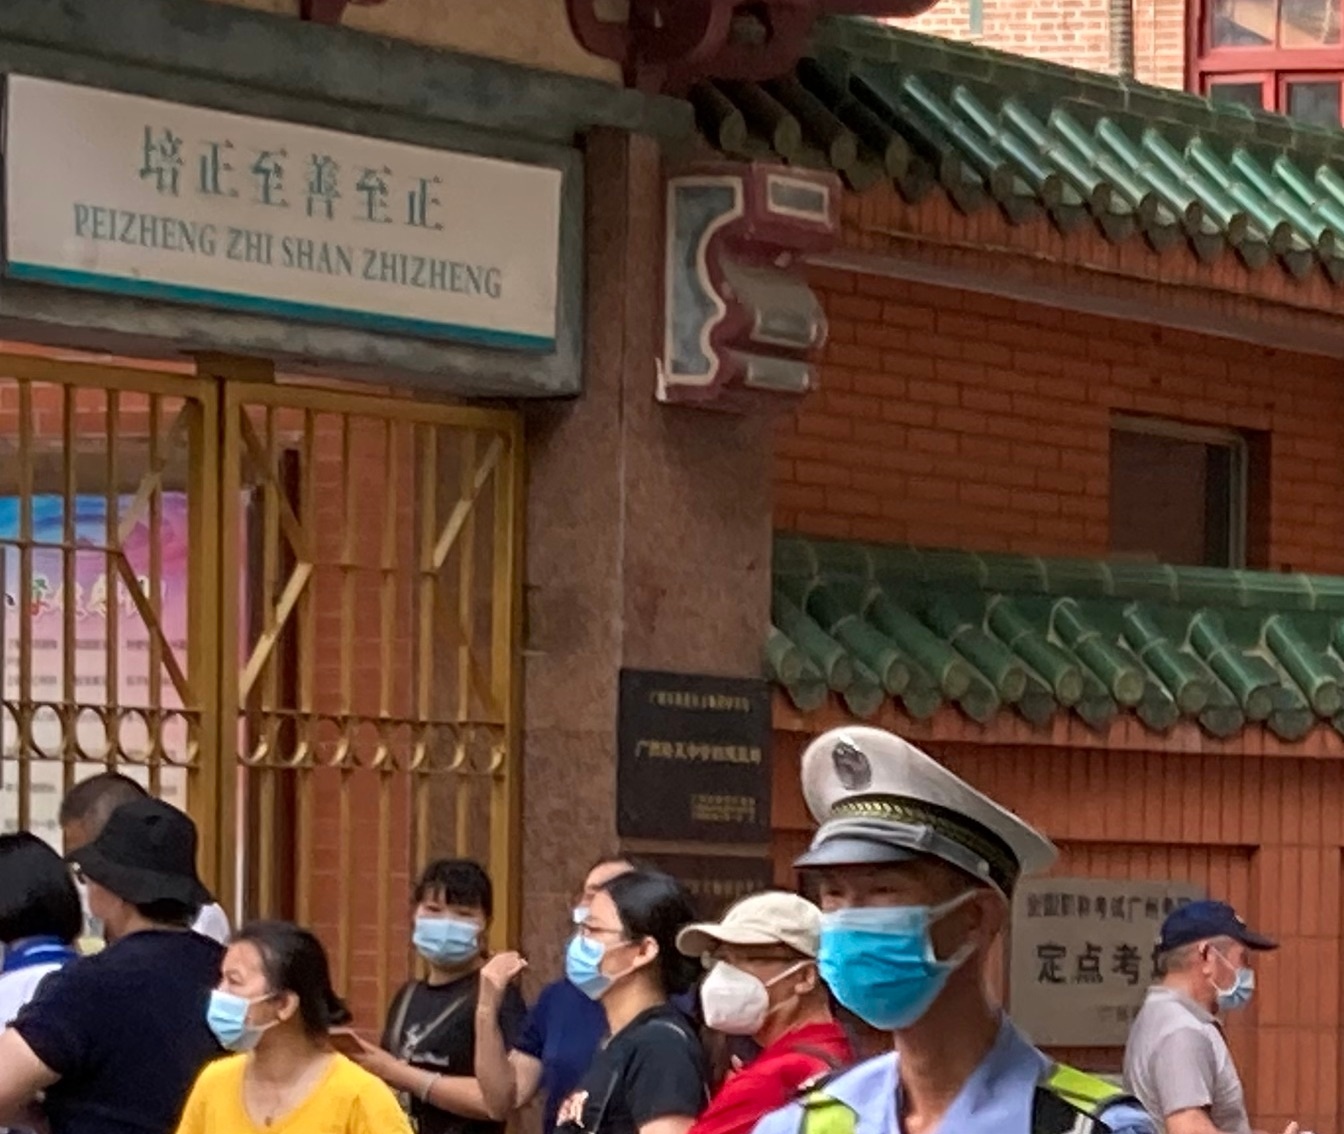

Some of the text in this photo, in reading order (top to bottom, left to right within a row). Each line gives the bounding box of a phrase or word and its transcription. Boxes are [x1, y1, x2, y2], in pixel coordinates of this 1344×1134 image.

[138, 125, 444, 231] 培正至善至正
[74, 203, 502, 299] PEIZHENG ZHI SHAN ZHIZHENG
